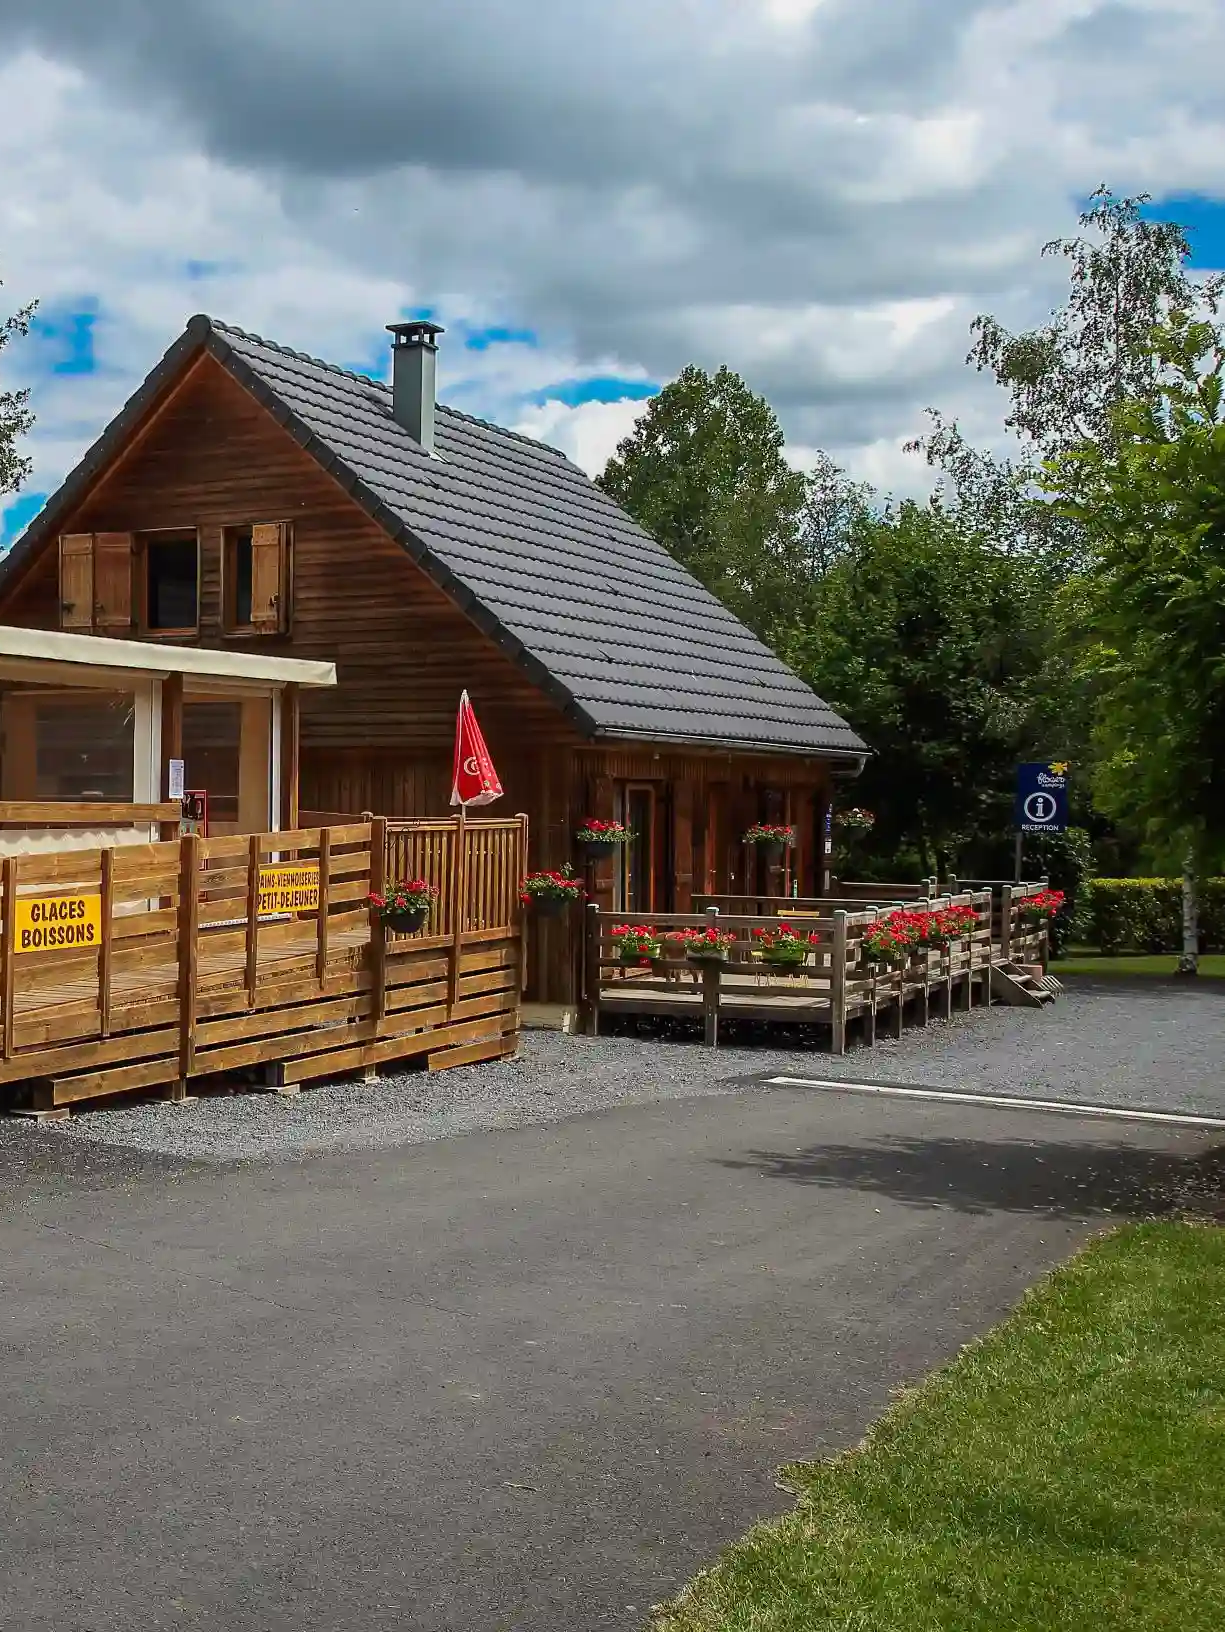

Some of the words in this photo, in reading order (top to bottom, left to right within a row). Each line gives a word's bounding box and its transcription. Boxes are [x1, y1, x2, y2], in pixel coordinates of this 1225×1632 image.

[1021, 823, 1059, 831] RECEPTION
[259, 871, 319, 889] AINS-VIENNOISERIES
[31, 900, 85, 923] GLACES
[21, 923, 95, 949] BOISSONS
